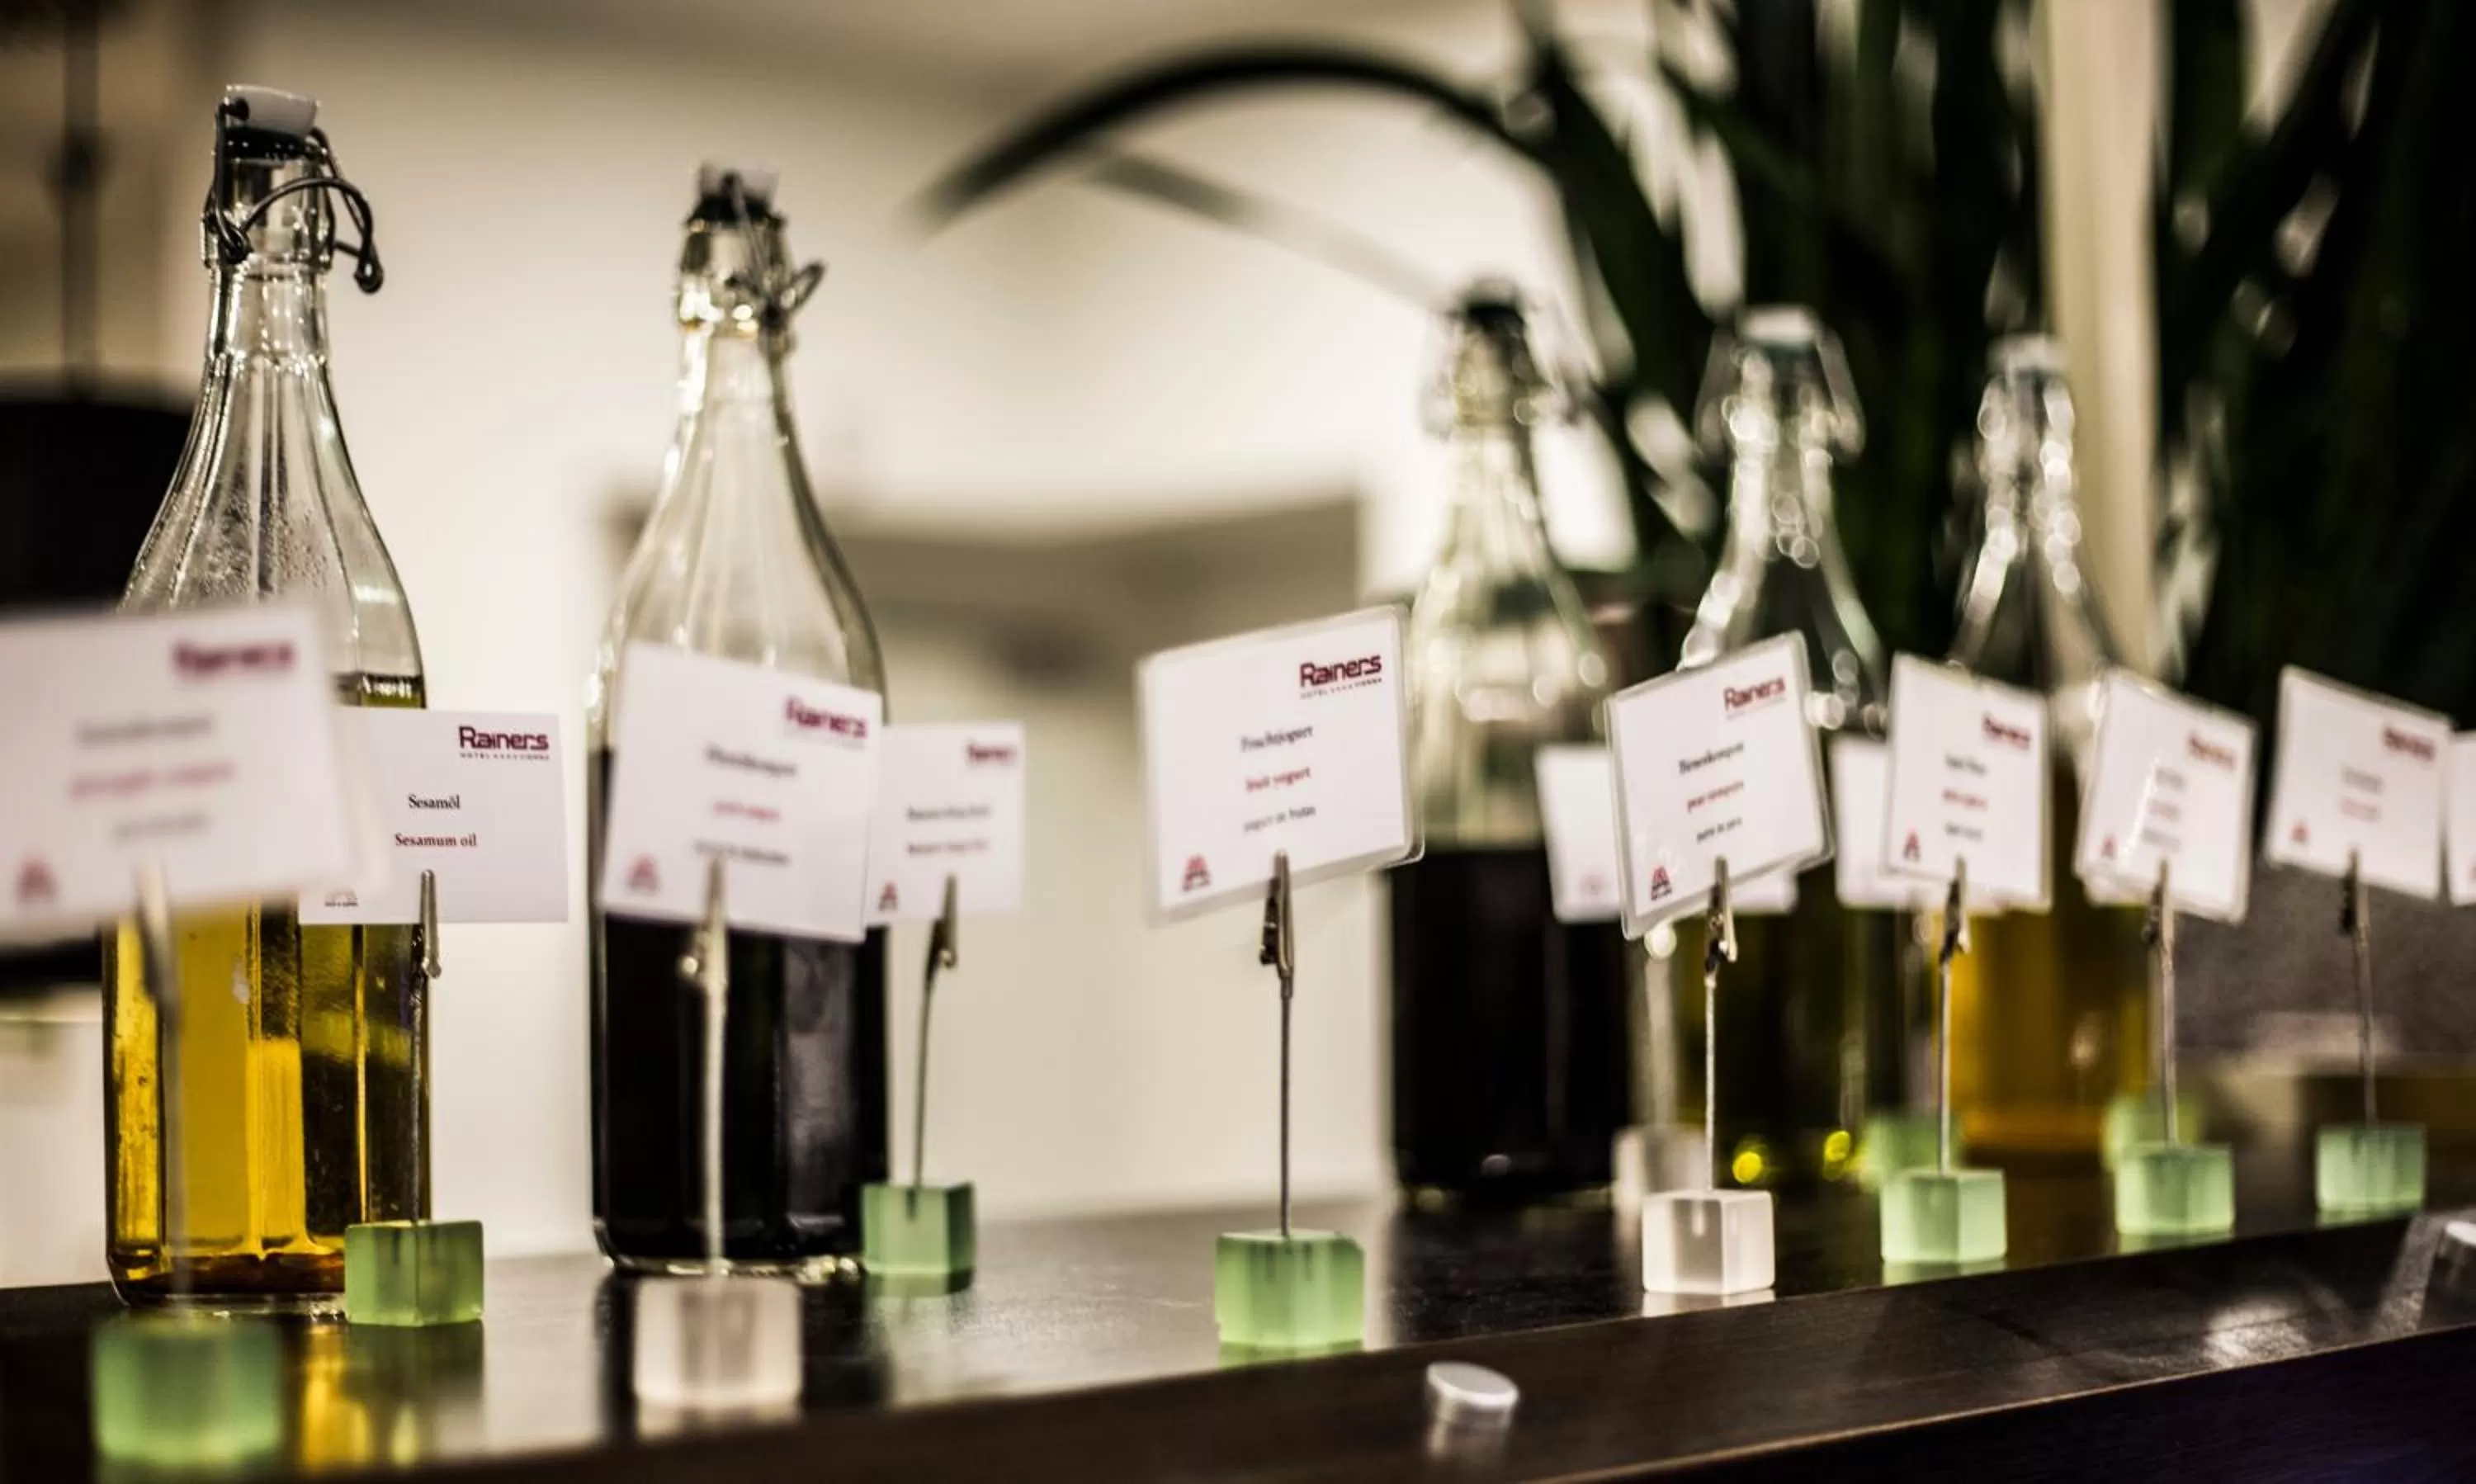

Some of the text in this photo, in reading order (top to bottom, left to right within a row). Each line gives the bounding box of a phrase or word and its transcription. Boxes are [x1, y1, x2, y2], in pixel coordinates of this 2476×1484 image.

[1300, 655, 1382, 688] Rainers
[459, 725, 549, 750] Rainers
[409, 793, 461, 809] Sesamöl
[395, 832, 476, 847] Sesamum oil
